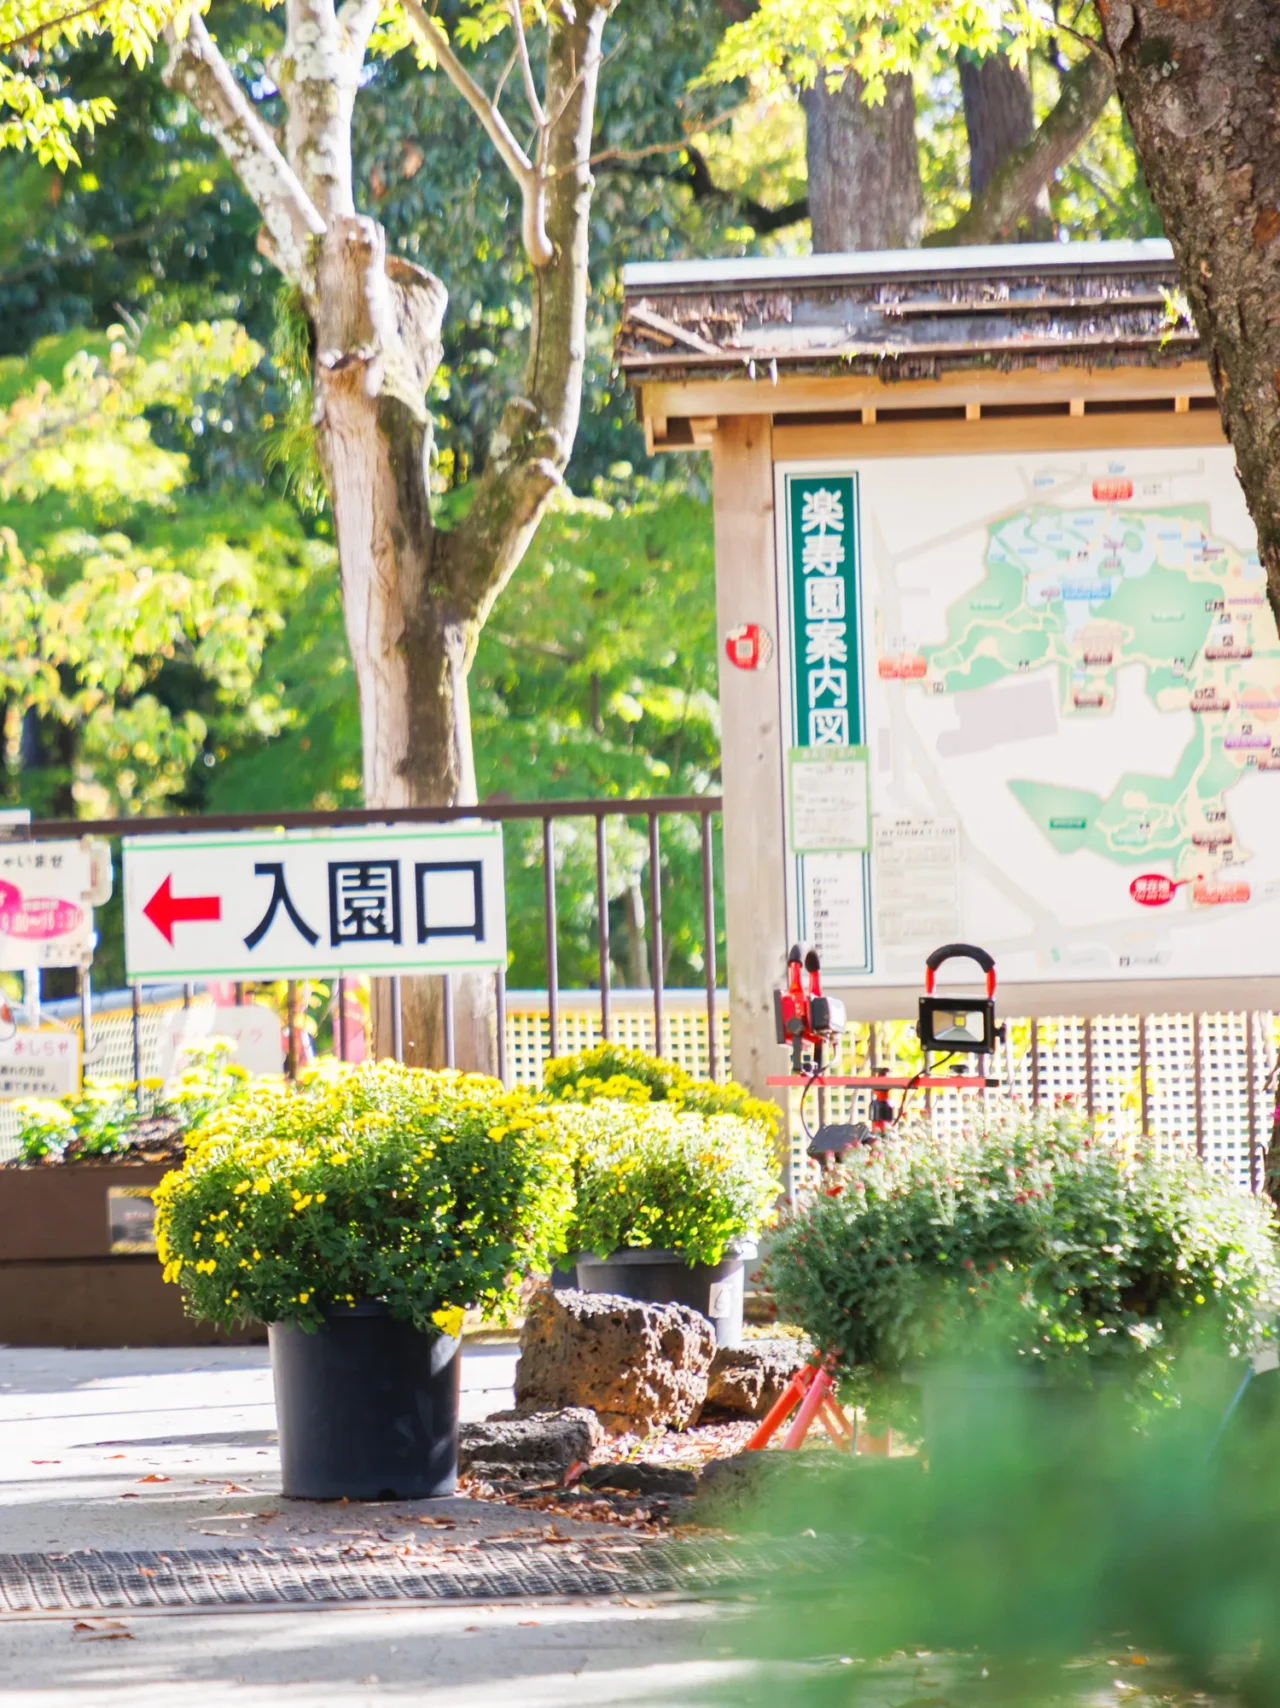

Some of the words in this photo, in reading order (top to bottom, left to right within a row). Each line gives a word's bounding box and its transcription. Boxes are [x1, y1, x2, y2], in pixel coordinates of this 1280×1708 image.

[801, 487, 850, 747] 楽寿園案内図
[243, 859, 485, 951] 入園口
